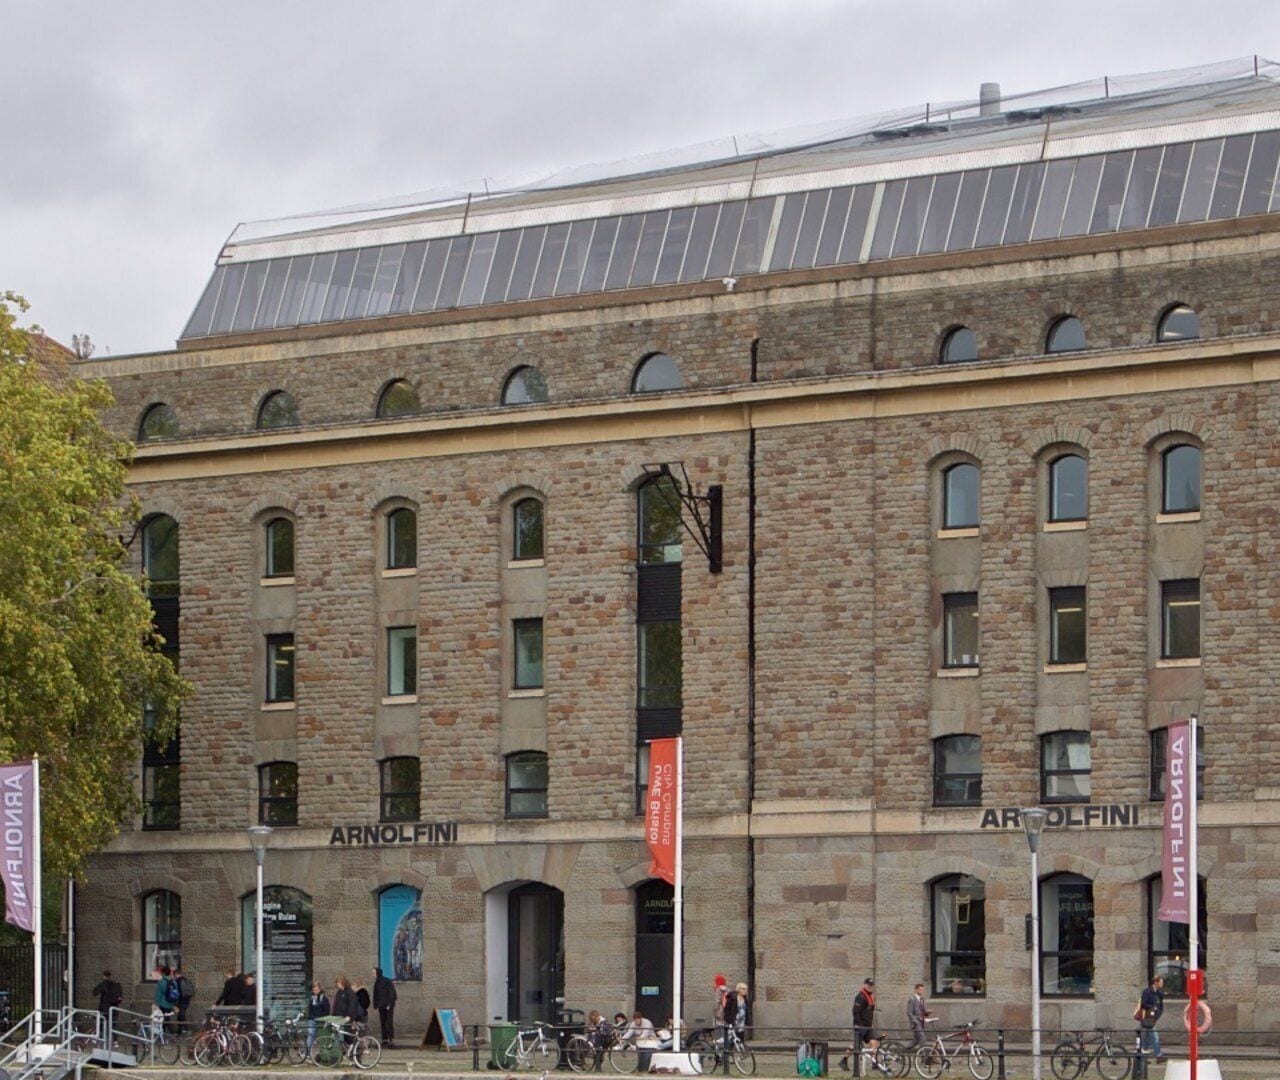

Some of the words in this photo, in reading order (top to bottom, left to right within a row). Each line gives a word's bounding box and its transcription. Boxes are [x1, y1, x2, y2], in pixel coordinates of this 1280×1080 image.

[980, 804, 1139, 828] AROLFINI
[330, 822, 458, 845] ARNOLFINI
[254, 902, 282, 911] Iagine
